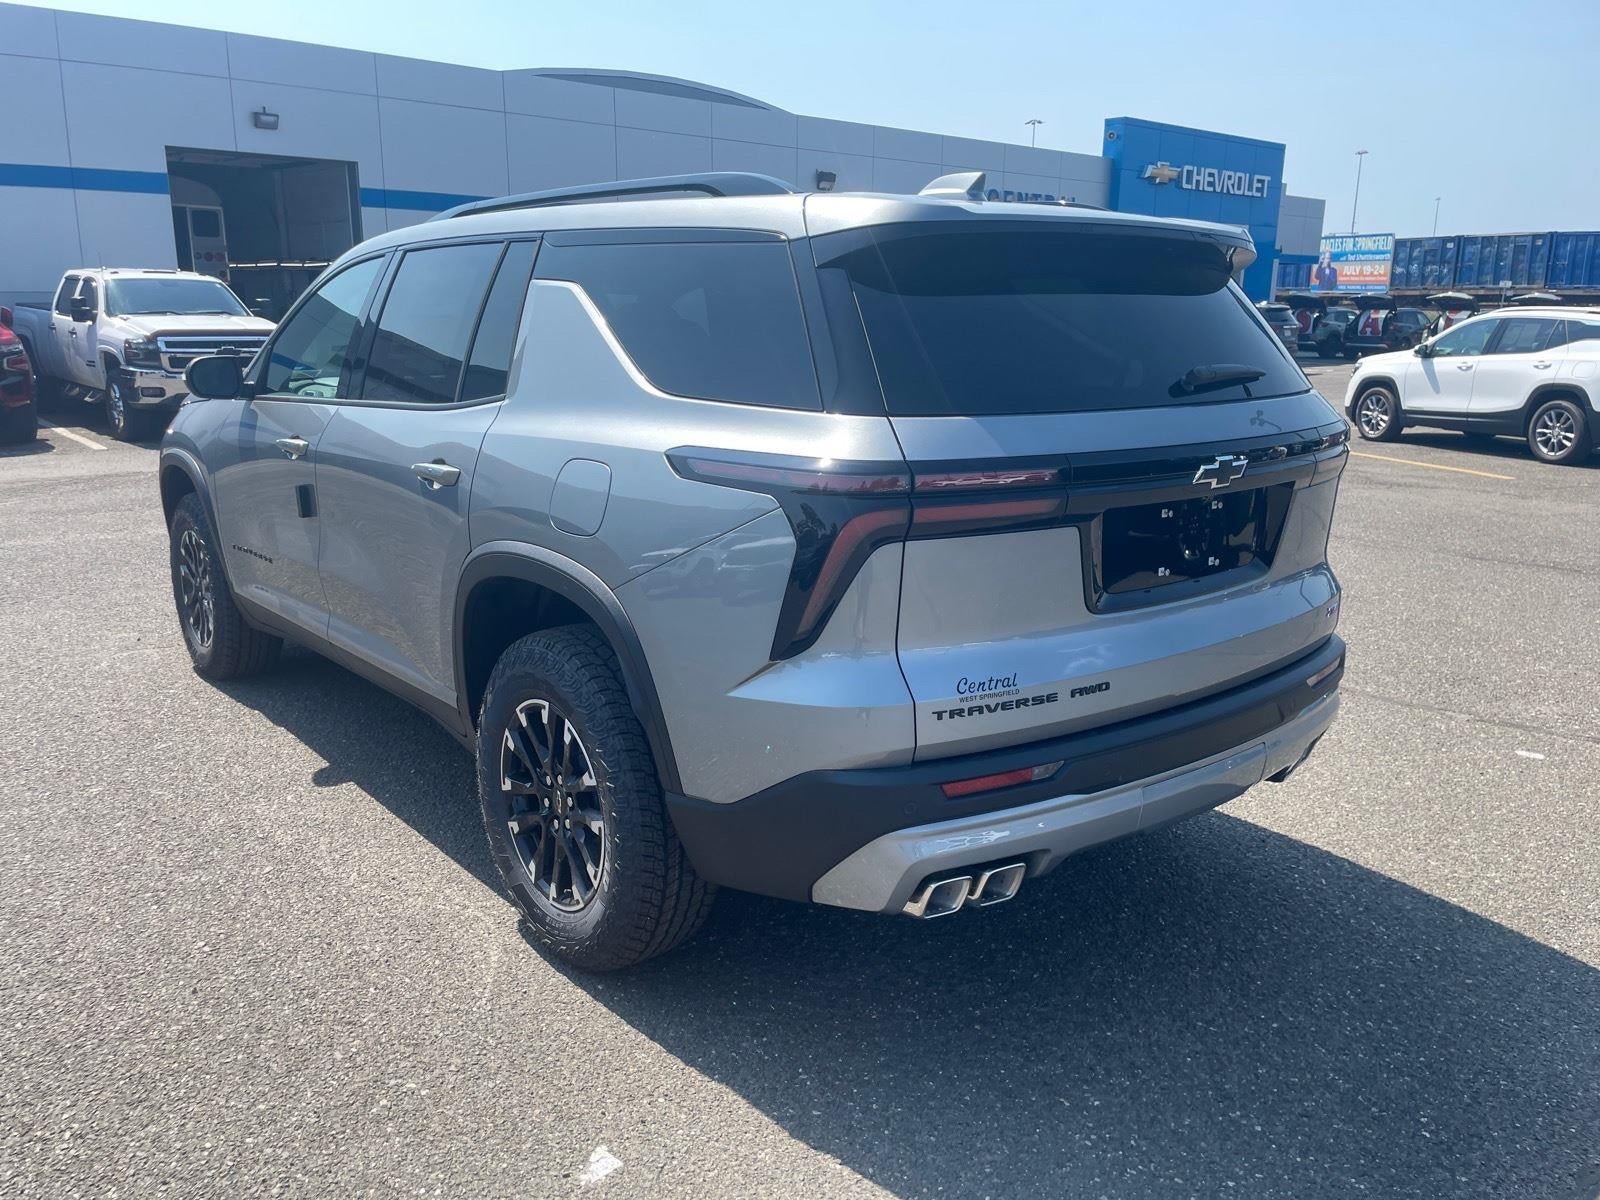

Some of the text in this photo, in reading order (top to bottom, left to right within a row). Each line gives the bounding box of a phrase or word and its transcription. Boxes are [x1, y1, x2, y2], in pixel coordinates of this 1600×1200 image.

[1182, 165, 1271, 198] CHEVROLET
[986, 188, 1076, 202] CENTR
[1343, 238, 1354, 251] FOR
[1355, 236, 1392, 251] SPRINGFIELD
[1343, 265, 1361, 275] JULY
[1363, 264, 1385, 275] 19-24
[956, 673, 1018, 694] Central
[932, 681, 1111, 721] TRAVERSE AWD
[959, 688, 1020, 703] WEST SPRINGFIELD
